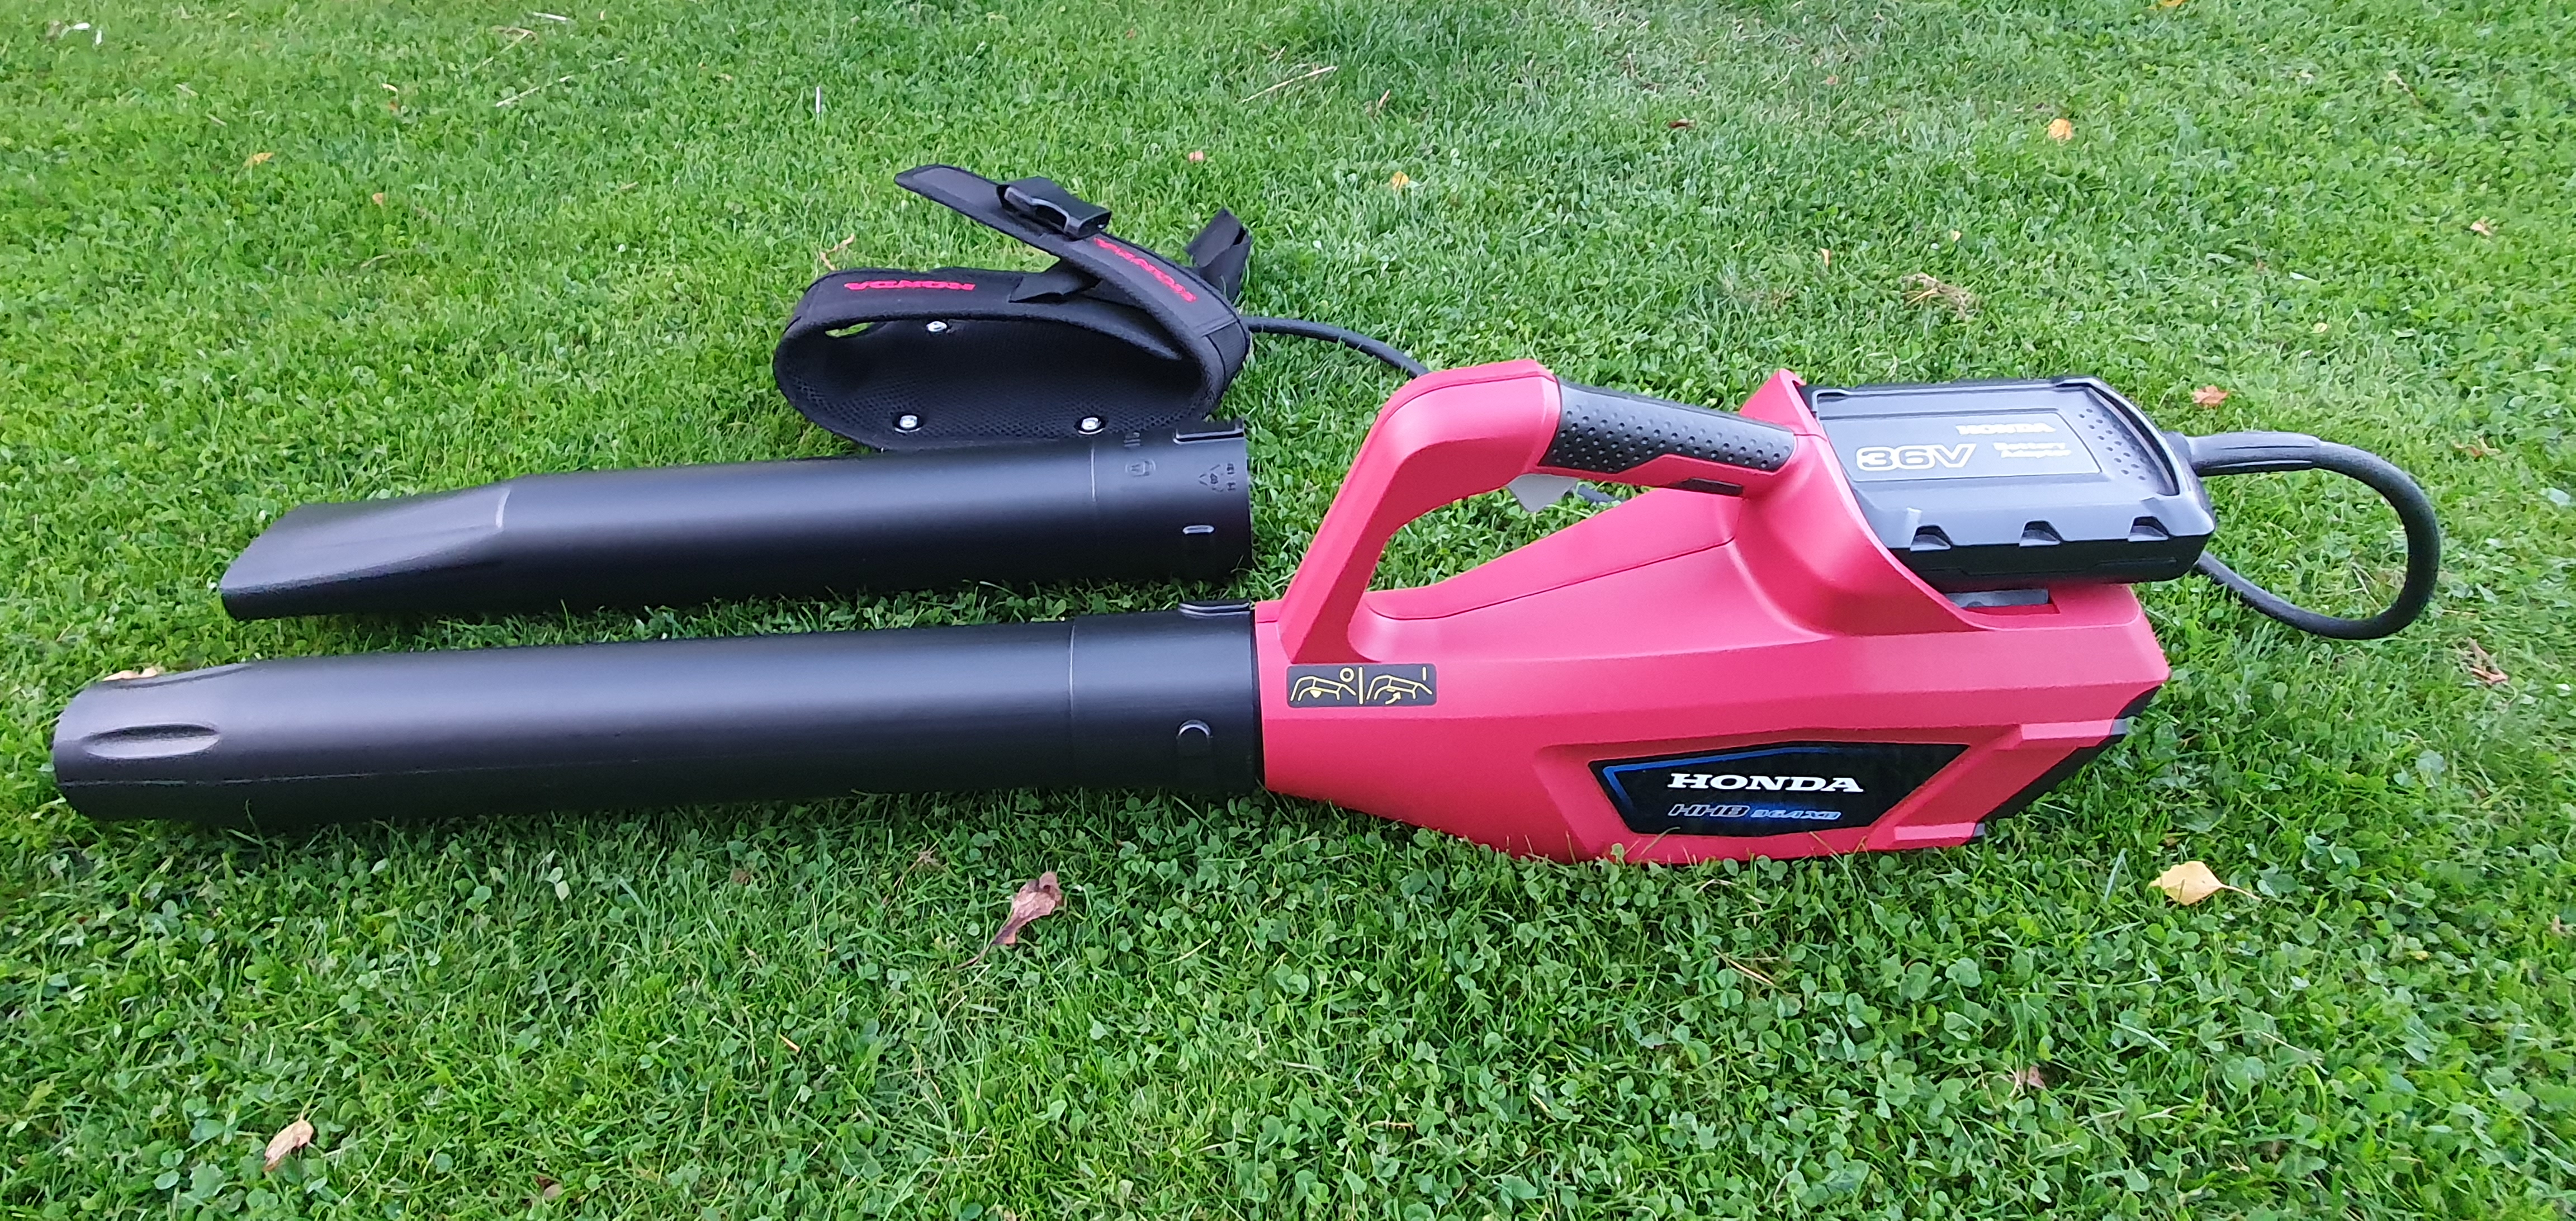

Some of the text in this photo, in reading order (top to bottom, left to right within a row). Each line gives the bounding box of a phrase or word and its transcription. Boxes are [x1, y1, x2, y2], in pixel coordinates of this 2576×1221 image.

[844, 280, 976, 290] HONDA
[1955, 423, 2057, 434] HONDA
[1856, 443, 1977, 471] 36V
[1667, 773, 1864, 792] HONDA
